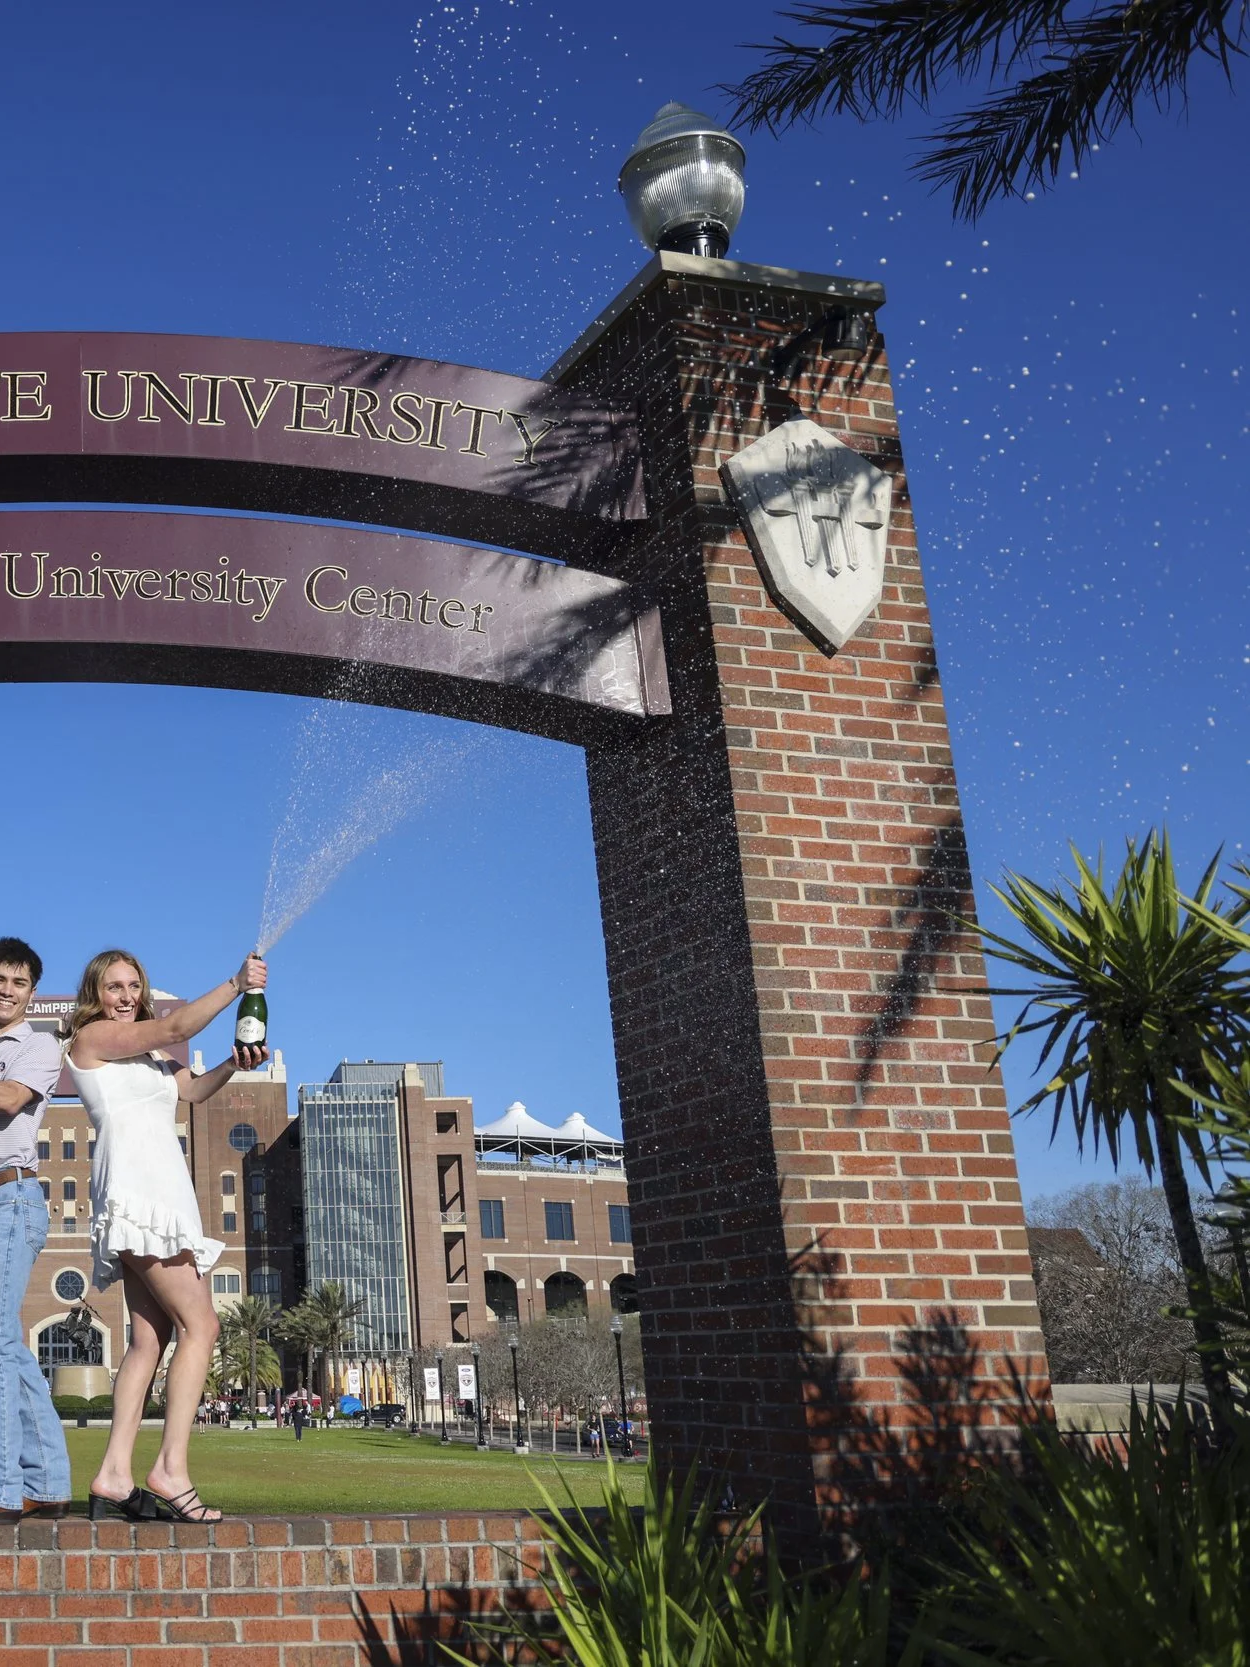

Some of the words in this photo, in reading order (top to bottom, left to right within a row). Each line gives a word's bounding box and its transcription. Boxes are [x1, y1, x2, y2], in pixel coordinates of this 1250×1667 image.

[81, 369, 559, 467] UNIVERSITY
[0, 551, 287, 622] University
[304, 565, 494, 634] Center
[25, 1002, 79, 1014] CAMPBE
